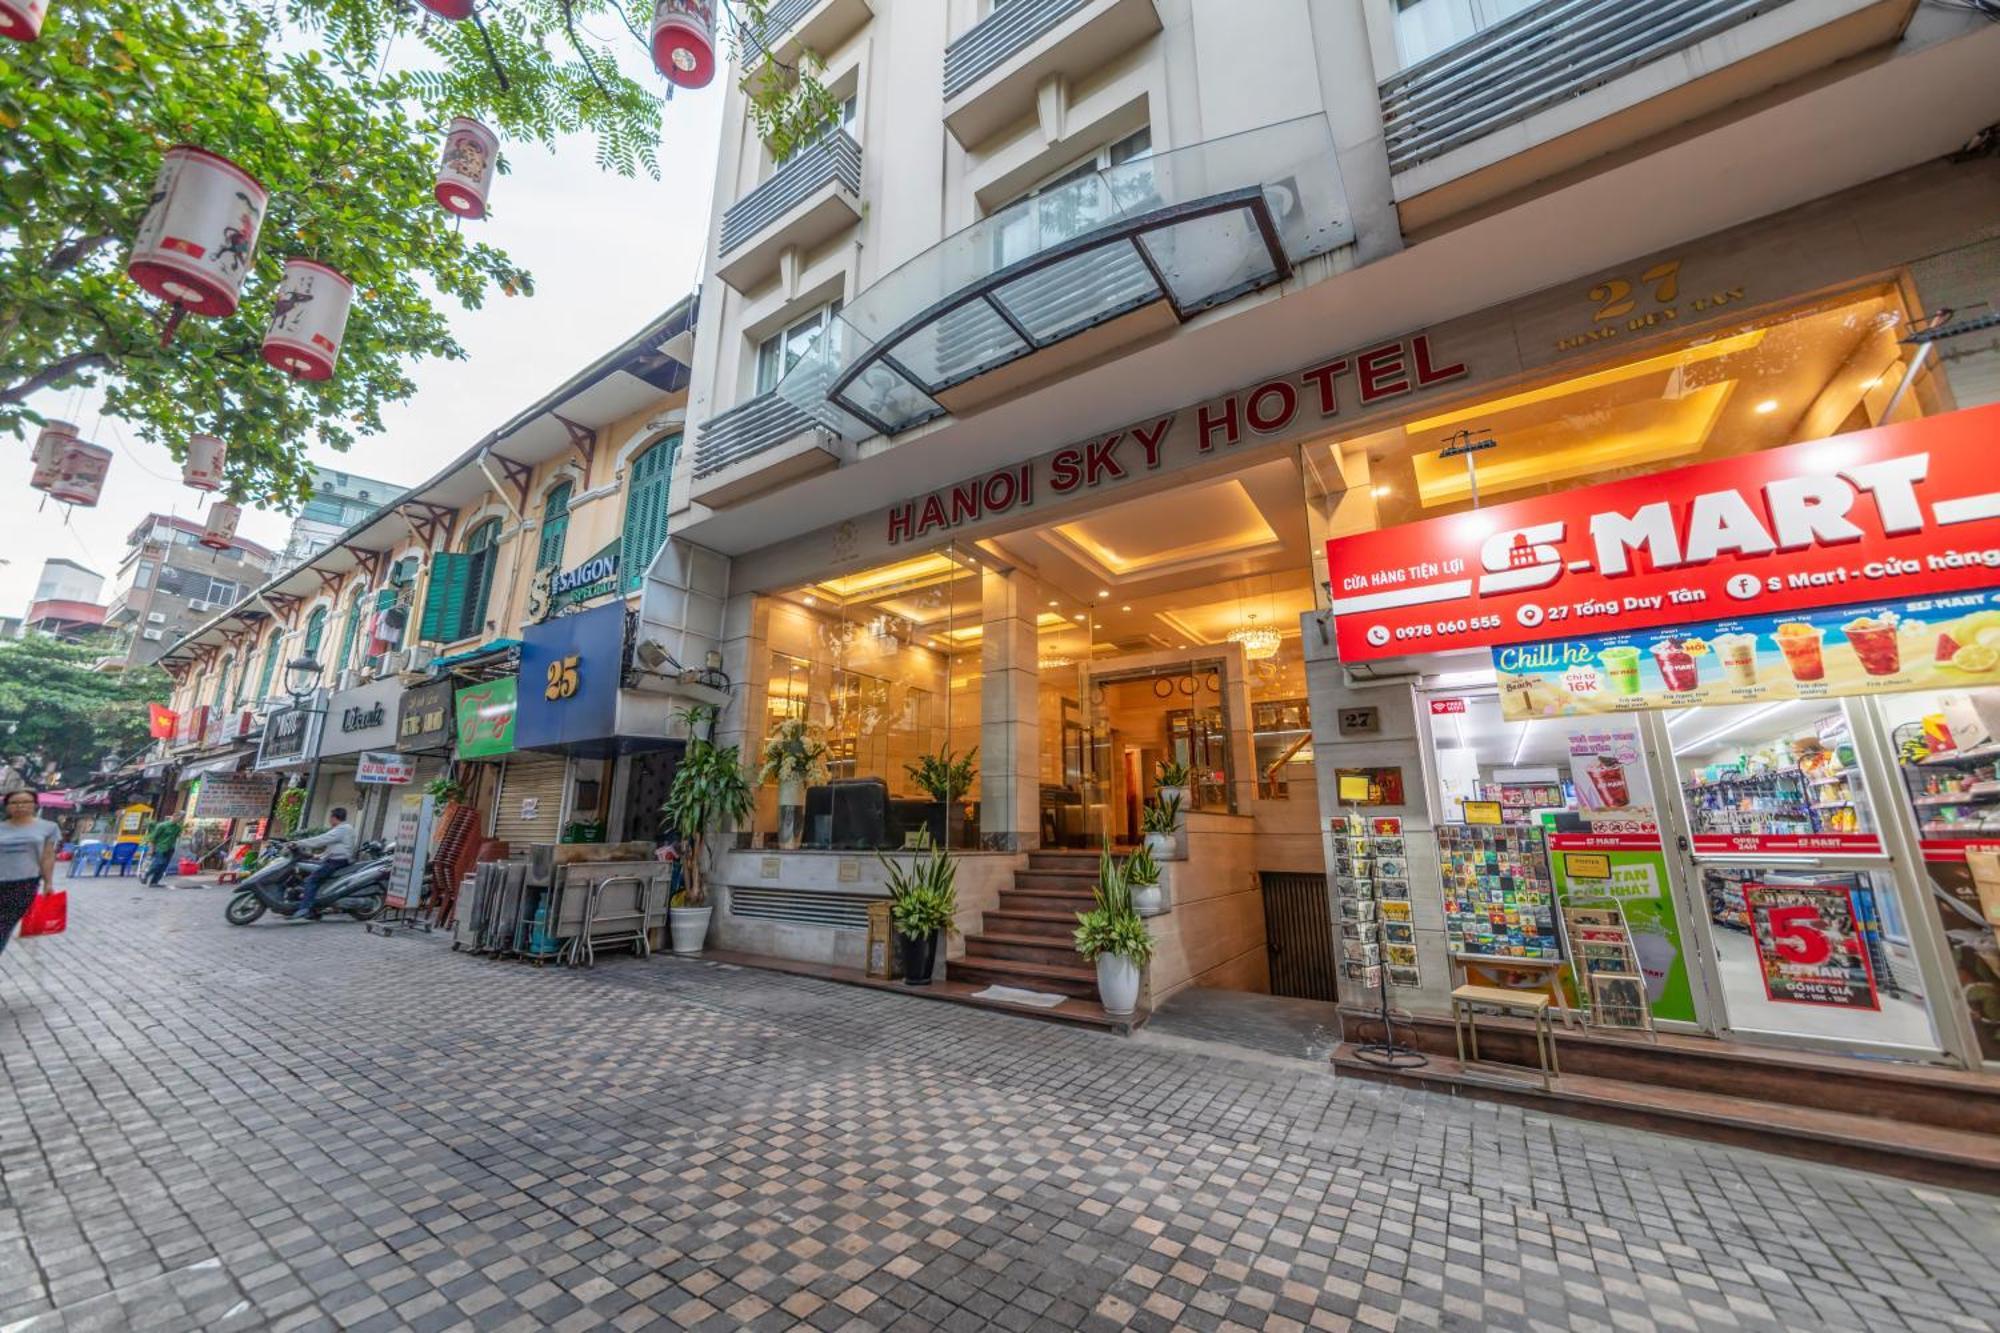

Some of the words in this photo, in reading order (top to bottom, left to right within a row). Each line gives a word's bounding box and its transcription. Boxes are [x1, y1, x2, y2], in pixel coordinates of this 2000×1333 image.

[1588, 257, 1685, 323] 27
[887, 463, 1034, 545] HANOI
[1050, 413, 1176, 493] SKY
[1196, 333, 1469, 456] HOTEL
[559, 555, 617, 592] SAIGON
[1371, 568, 1406, 586] HÀNG
[1408, 562, 1438, 580] TIỆN
[1442, 557, 1465, 575] LỢI
[1788, 567, 1847, 589] Mart
[1863, 556, 1922, 579] Cửa
[1926, 546, 2000, 569] hàng
[1548, 606, 1570, 621] 27
[1573, 598, 1620, 617] Tống
[1623, 595, 1663, 611] Duy
[1667, 588, 1707, 604] Tân
[1395, 624, 1434, 641] 0978
[1436, 618, 1468, 635] 060
[1470, 614, 1502, 630] 555
[1500, 643, 1560, 671] Chill
[1562, 642, 1595, 665] hè
[546, 656, 579, 700] 25
[1506, 681, 1533, 692] Beach
[1568, 681, 1597, 693] 16K
[1345, 713, 1371, 727] 27
[1767, 906, 1833, 965] 5
